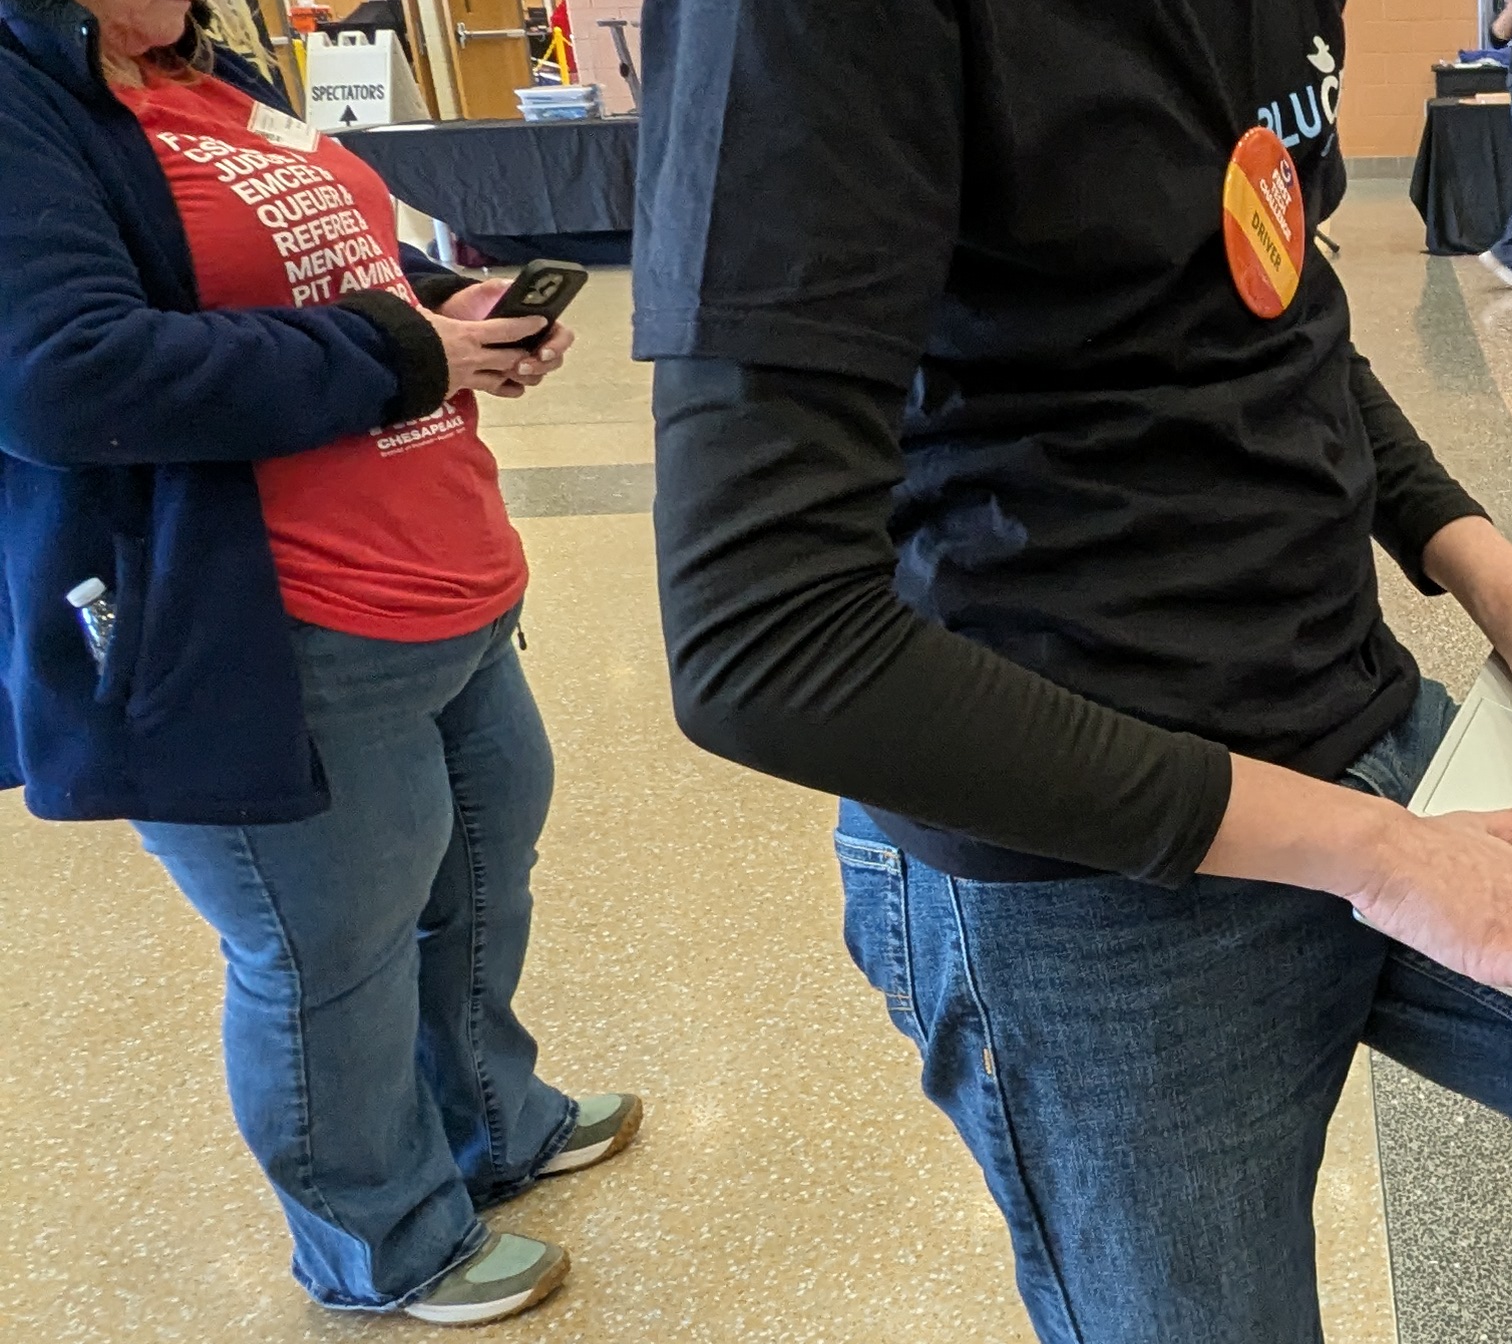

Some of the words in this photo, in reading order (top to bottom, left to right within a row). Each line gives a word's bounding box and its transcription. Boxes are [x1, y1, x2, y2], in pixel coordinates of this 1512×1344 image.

[311, 84, 385, 102] SPECTATORS
[230, 164, 319, 206] EMCEE
[256, 186, 342, 229] QUEUER
[272, 211, 361, 258] REFEREE
[1251, 209, 1282, 273] DRIVER
[284, 236, 375, 284] MENTOR
[291, 275, 333, 308] PIT
[377, 415, 465, 450] CHESAPEAKE
